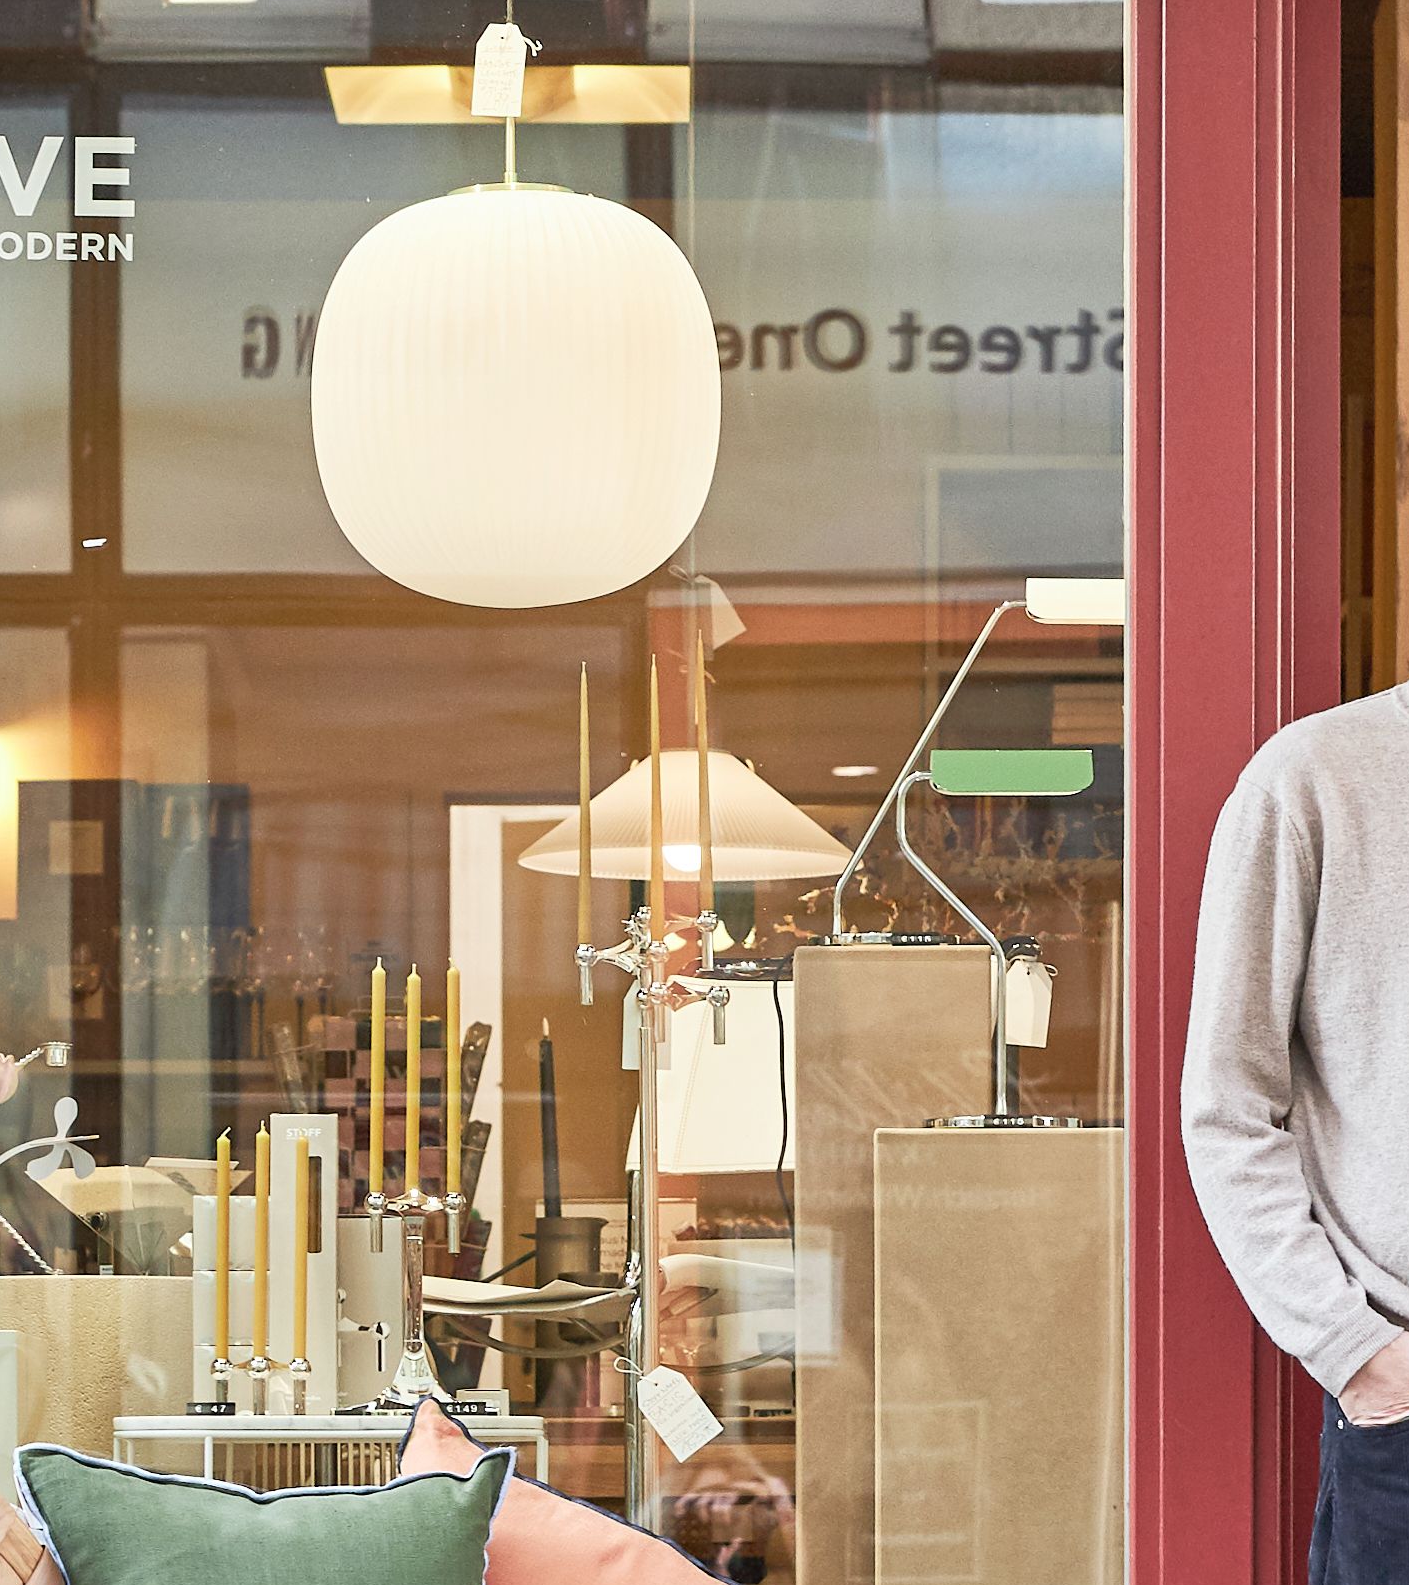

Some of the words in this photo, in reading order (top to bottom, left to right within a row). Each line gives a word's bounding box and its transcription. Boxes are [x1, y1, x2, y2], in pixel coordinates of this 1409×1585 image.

[286, 1127, 322, 1137] STOFF
[210, 1404, 227, 1413] 47
[446, 1404, 478, 1413] €149
